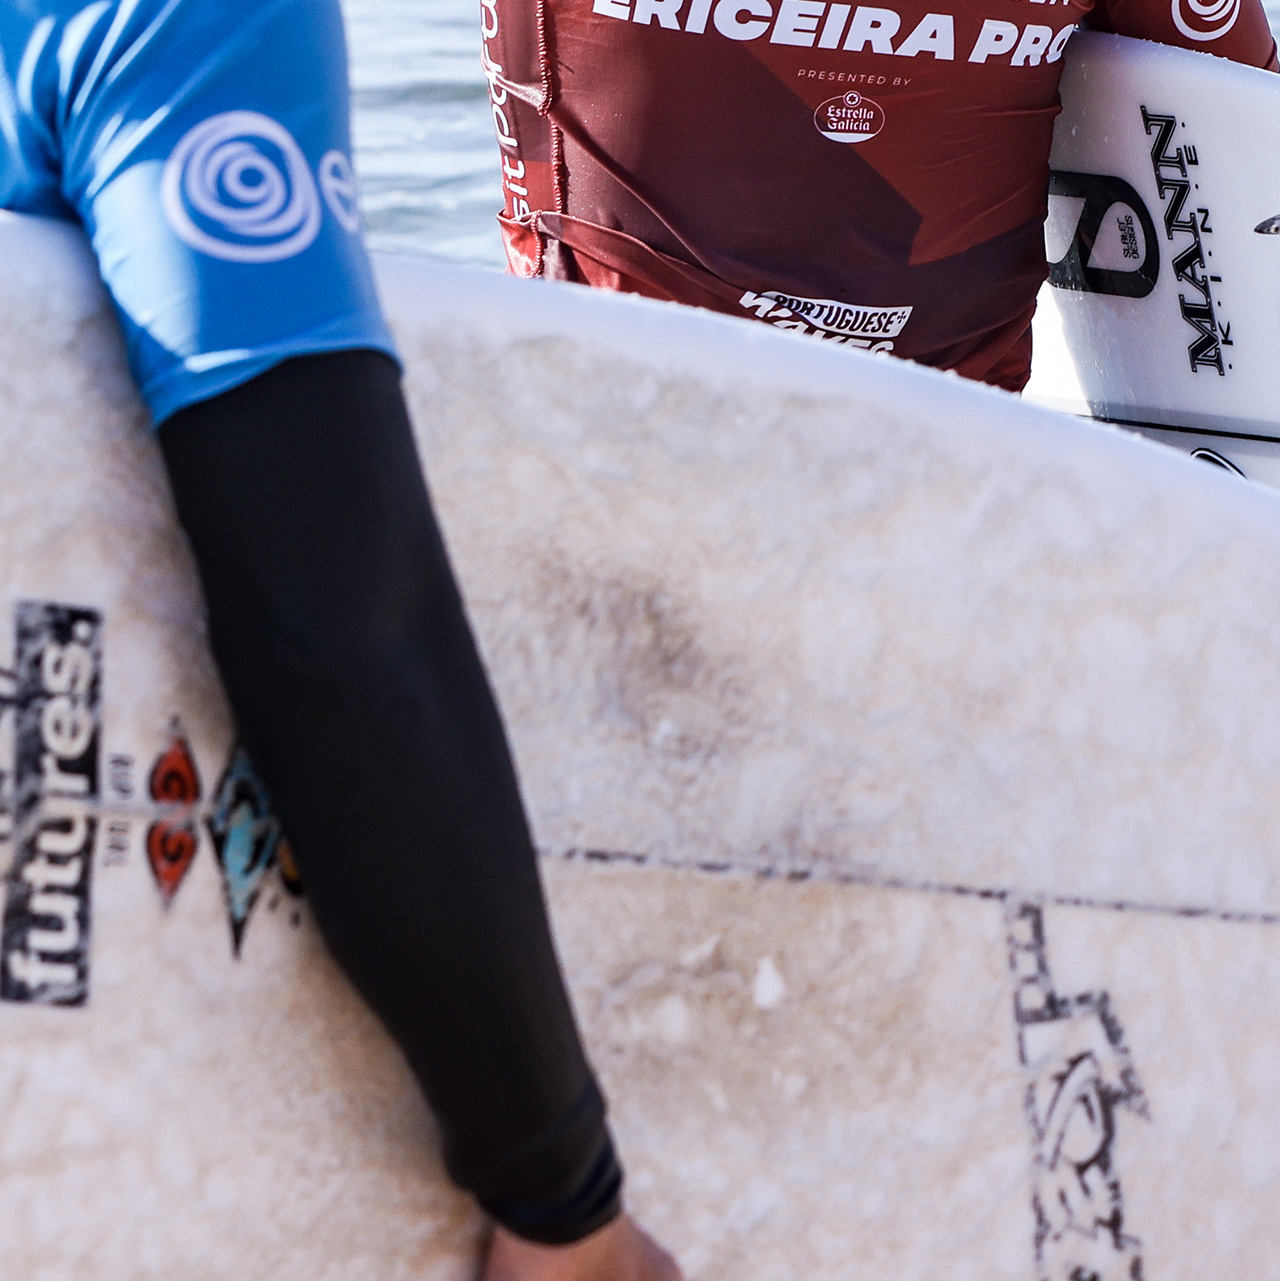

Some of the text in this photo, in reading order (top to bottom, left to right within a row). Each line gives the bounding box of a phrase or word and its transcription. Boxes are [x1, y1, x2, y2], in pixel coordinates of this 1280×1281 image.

[968, 18, 1075, 67] PRO
[797, 69, 911, 86] PRESENTED BY
[826, 105, 874, 119] Estrella
[827, 118, 870, 131] Galicia
[1140, 104, 1225, 377] MANN
[774, 294, 898, 333] PORTUGUESE
[9, 620, 95, 986] futures.
